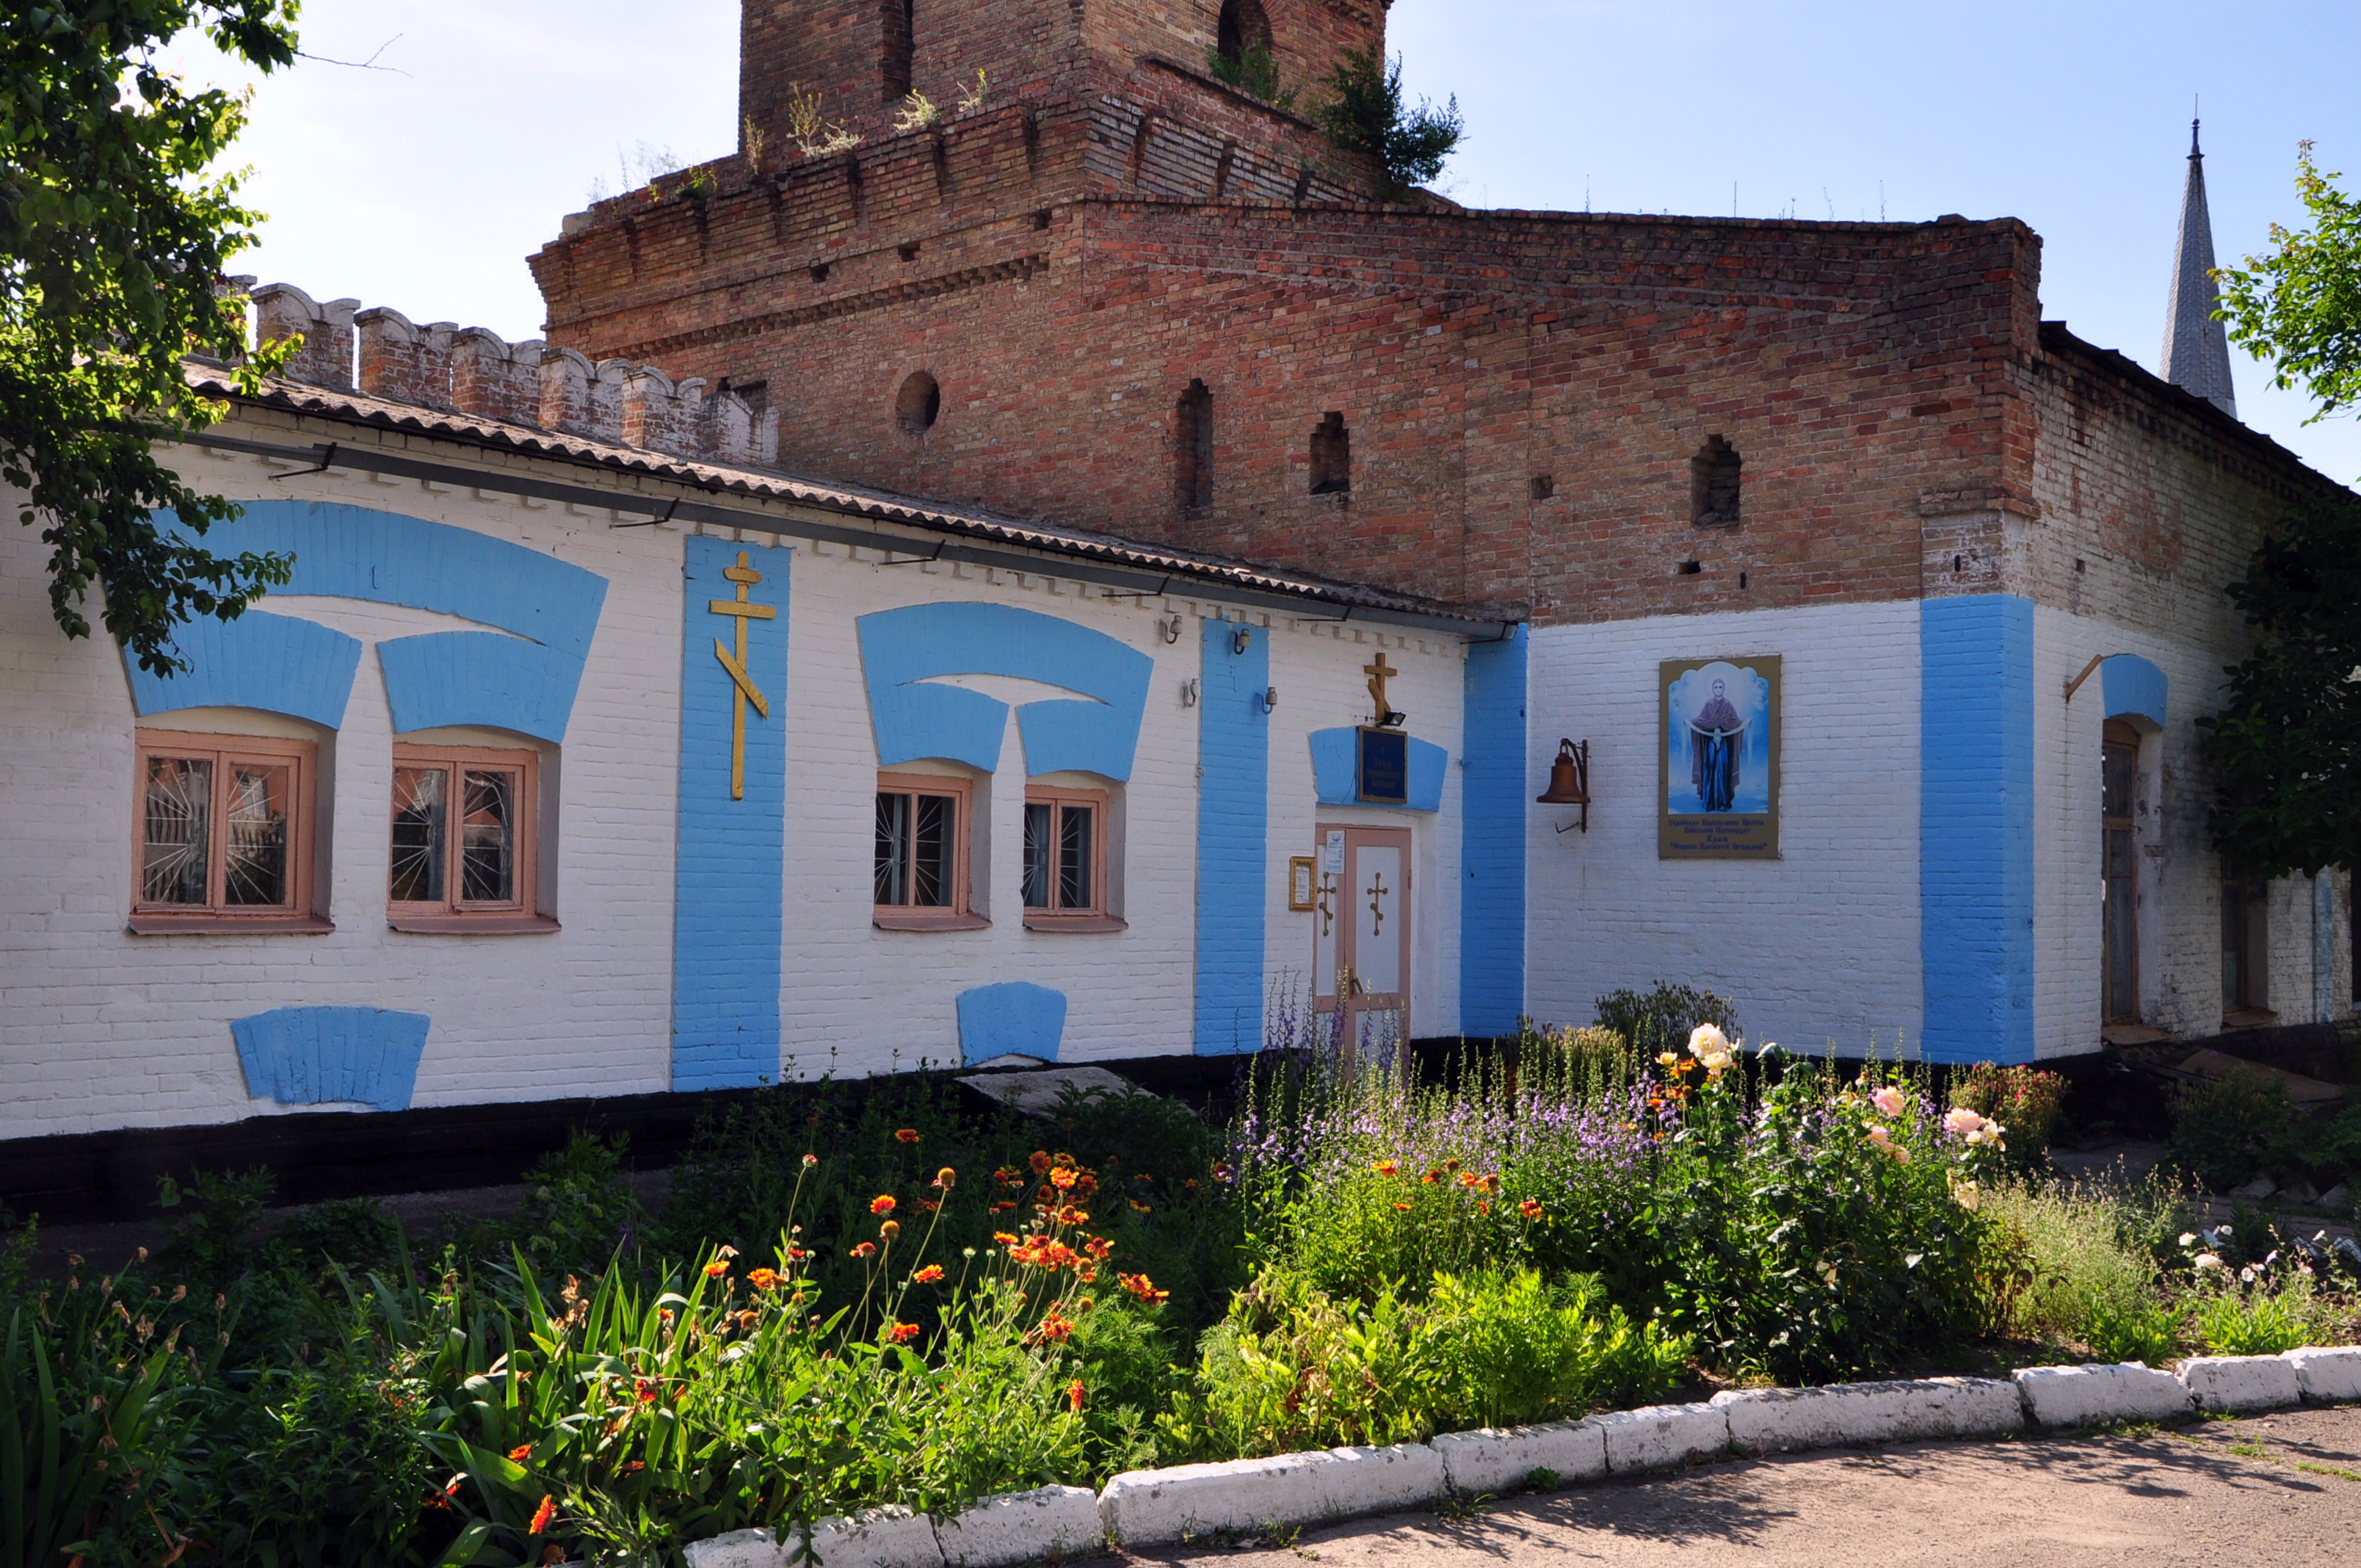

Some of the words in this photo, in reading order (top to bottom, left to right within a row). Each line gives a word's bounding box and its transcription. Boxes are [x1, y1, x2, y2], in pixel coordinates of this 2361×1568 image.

[1742, 819, 1764, 827] Церква
[1716, 827, 1750, 835] Патріархат
[1707, 834, 1729, 843] Храм
